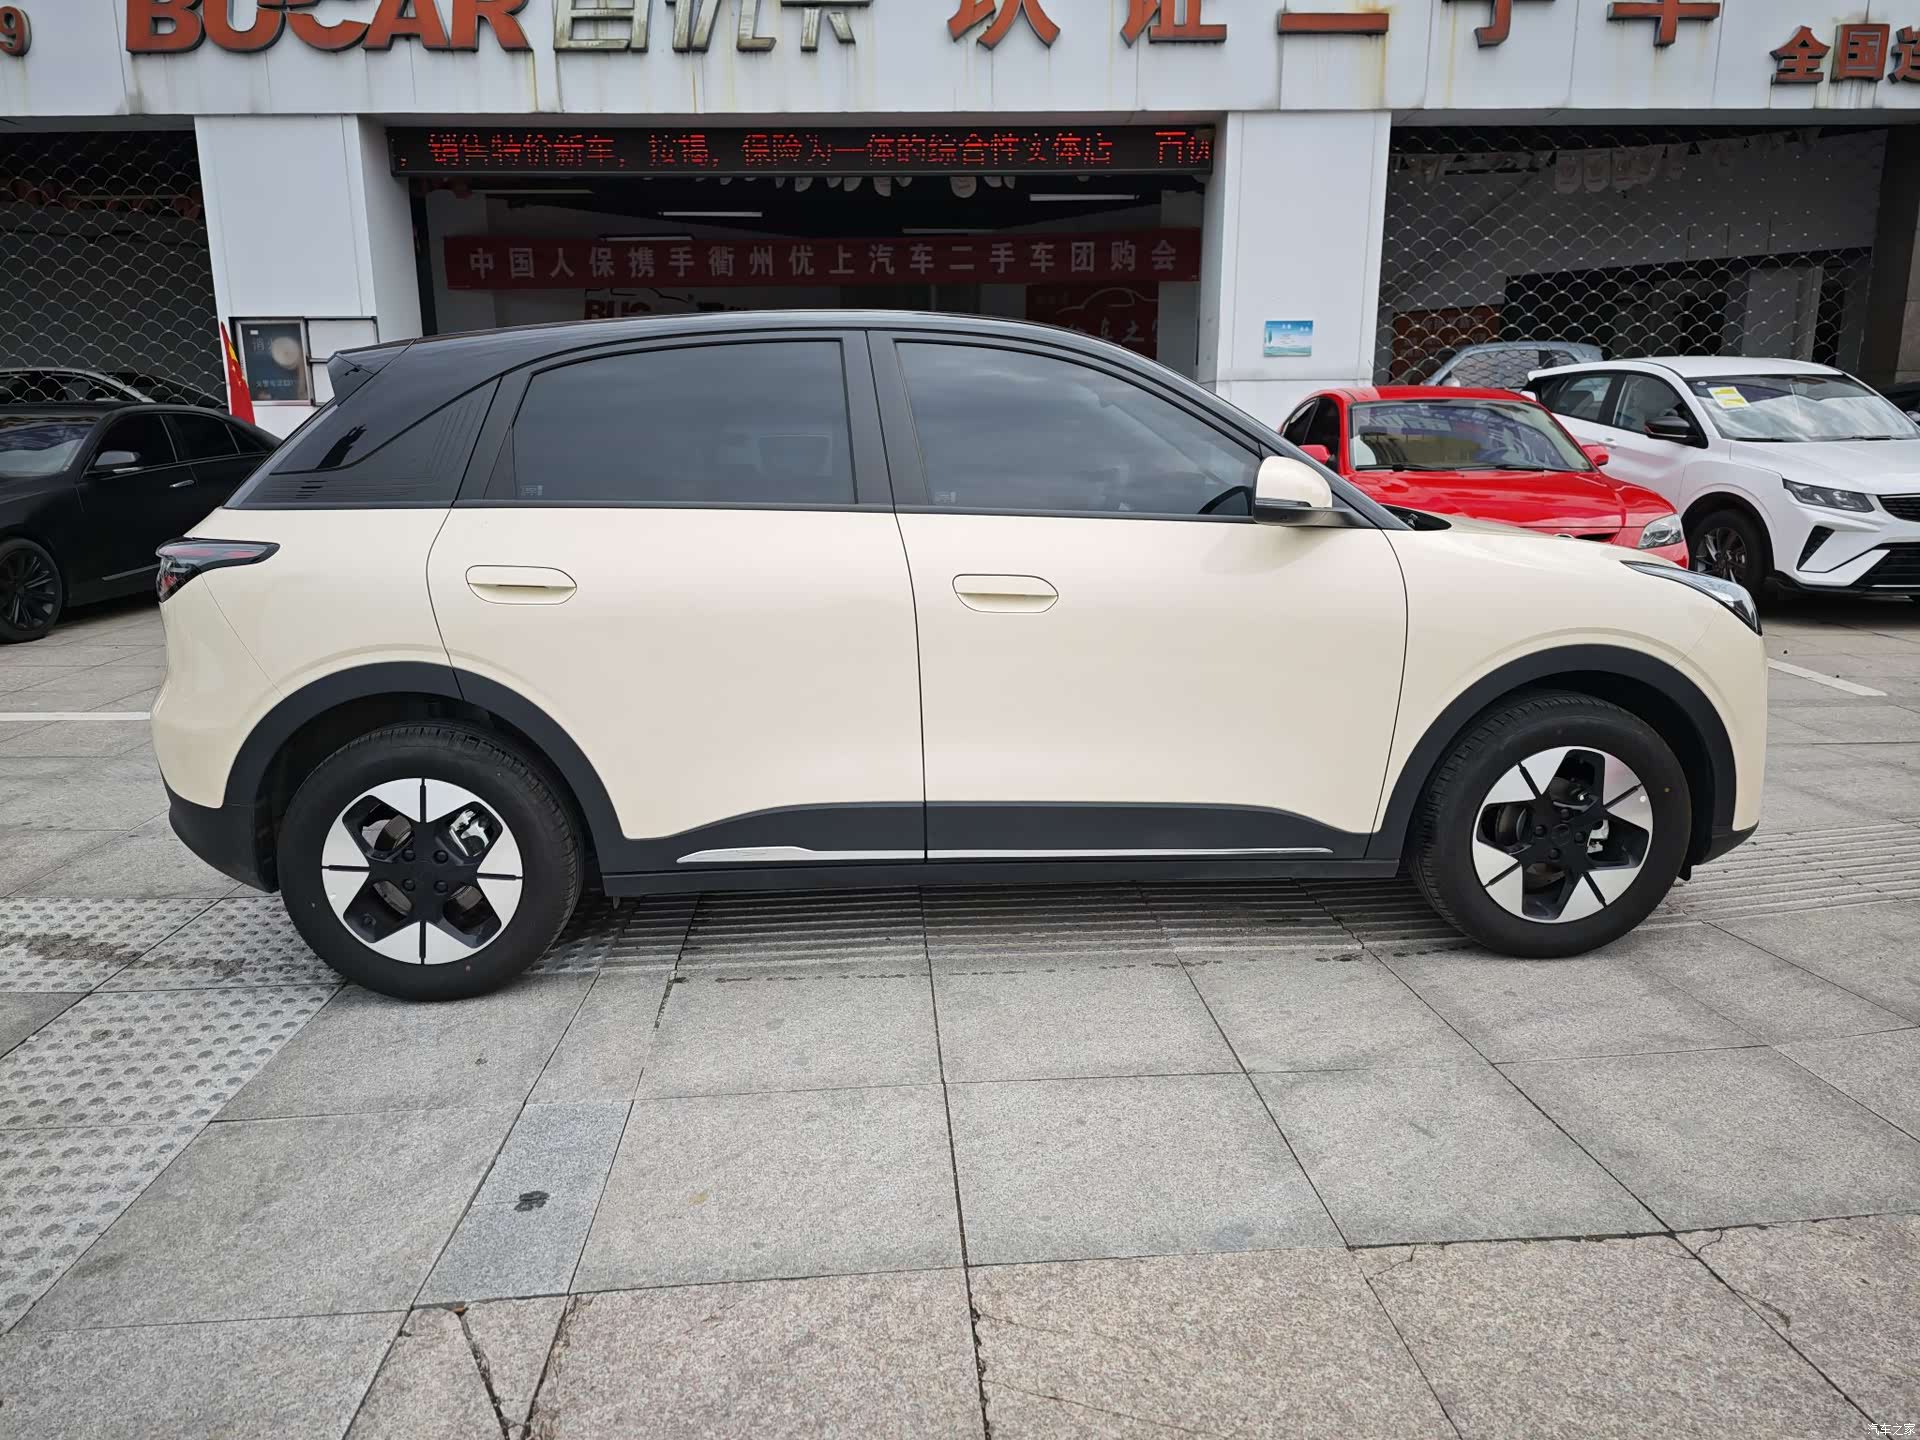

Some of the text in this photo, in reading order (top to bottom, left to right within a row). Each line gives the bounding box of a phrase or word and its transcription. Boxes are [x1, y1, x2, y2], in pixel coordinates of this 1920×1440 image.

[470, 241, 1177, 279] 中国人保携手衢州优上汽车二手车团购会
